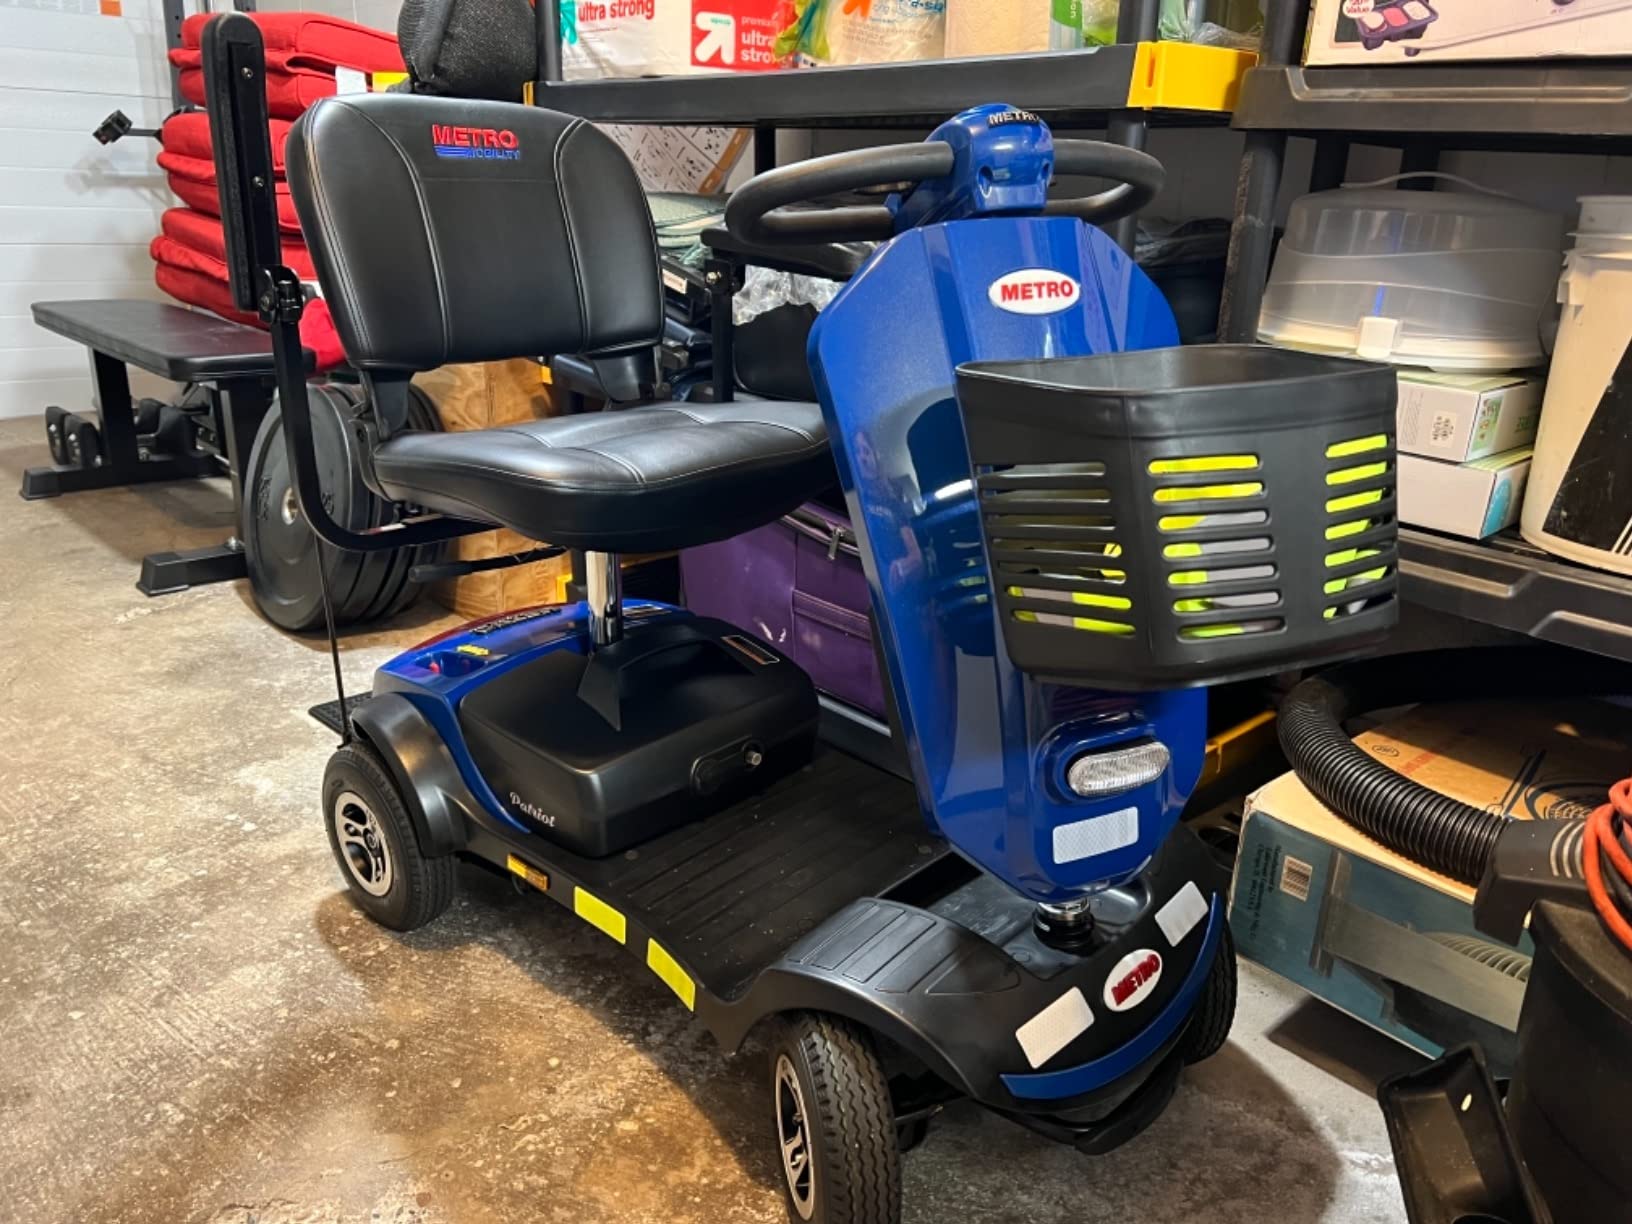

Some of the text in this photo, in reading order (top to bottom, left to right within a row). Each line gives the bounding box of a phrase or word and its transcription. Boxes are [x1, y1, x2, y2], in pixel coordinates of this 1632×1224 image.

[578, 0, 655, 22] ultra strong
[431, 124, 519, 150] METRO
[1000, 279, 1074, 302] METRO
[509, 791, 555, 828] Patriot
[1111, 953, 1161, 1007] METRO
